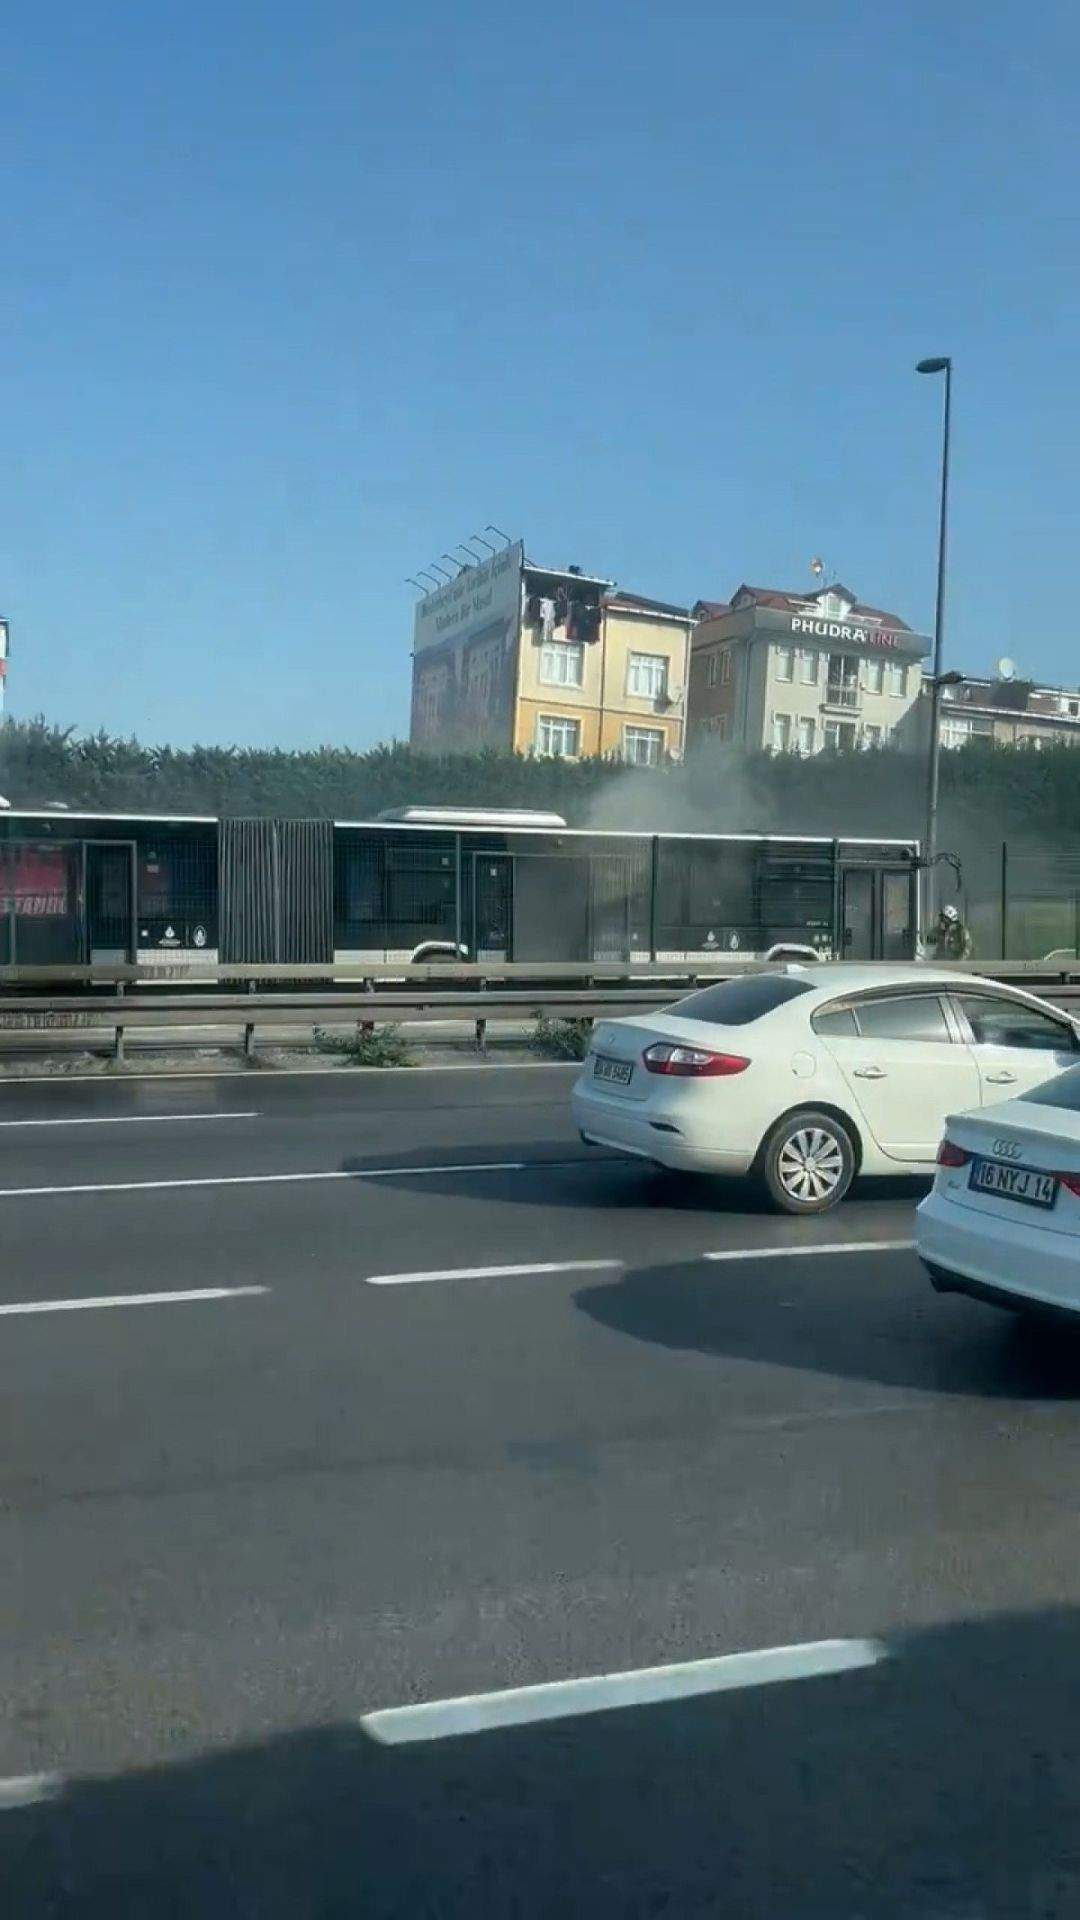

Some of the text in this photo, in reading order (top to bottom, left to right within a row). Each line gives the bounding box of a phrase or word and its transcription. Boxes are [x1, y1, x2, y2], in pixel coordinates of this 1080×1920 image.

[791, 618, 866, 642] PHUDRA
[980, 1163, 1052, 1200] 16 NYJ 14
